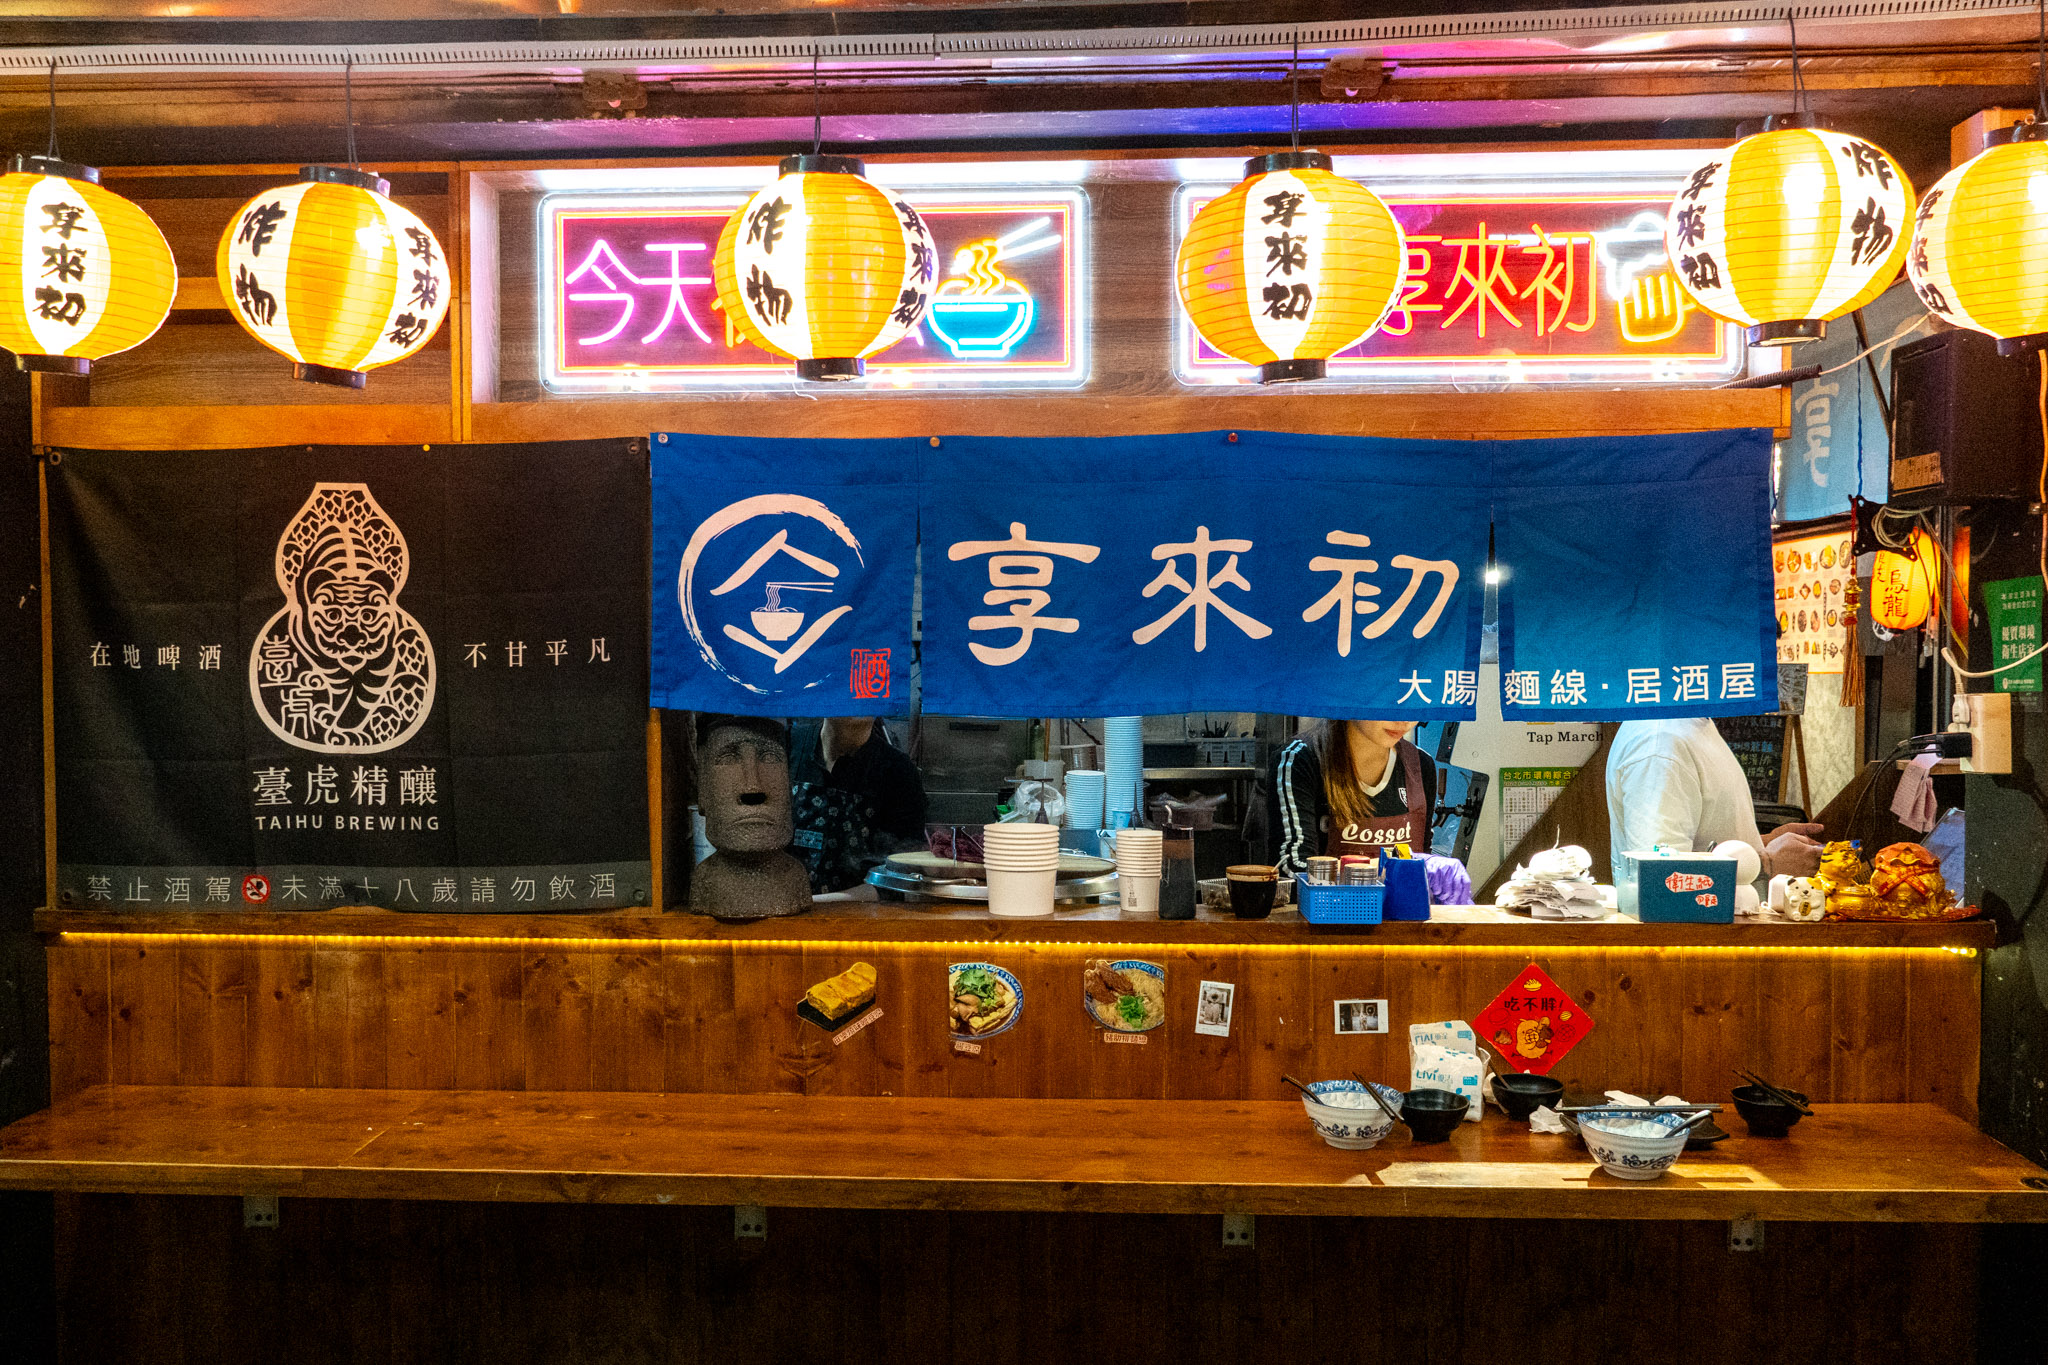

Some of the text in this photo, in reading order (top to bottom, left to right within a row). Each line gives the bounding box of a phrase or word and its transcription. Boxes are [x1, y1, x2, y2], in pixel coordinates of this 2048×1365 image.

[33, 202, 88, 327] 享來初
[235, 201, 287, 326] 炸物
[746, 197, 793, 326] 炸物
[1261, 190, 1312, 321] 享來初
[1681, 161, 1722, 289] 享來初
[1842, 142, 1893, 266] 炸物
[386, 226, 440, 348] 享來初
[463, 637, 611, 668] 不甘平凡
[948, 522, 1461, 666] 享來初
[89, 641, 223, 671] 在地啤酒
[252, 763, 438, 808] 臺虎精釀
[1526, 730, 1604, 746] Tap March
[255, 815, 440, 832] TAIHU BREWING
[1341, 821, 1412, 843] Cosset
[88, 872, 616, 905] 禁止酒駕 未滿十八歲請勿飲酒
